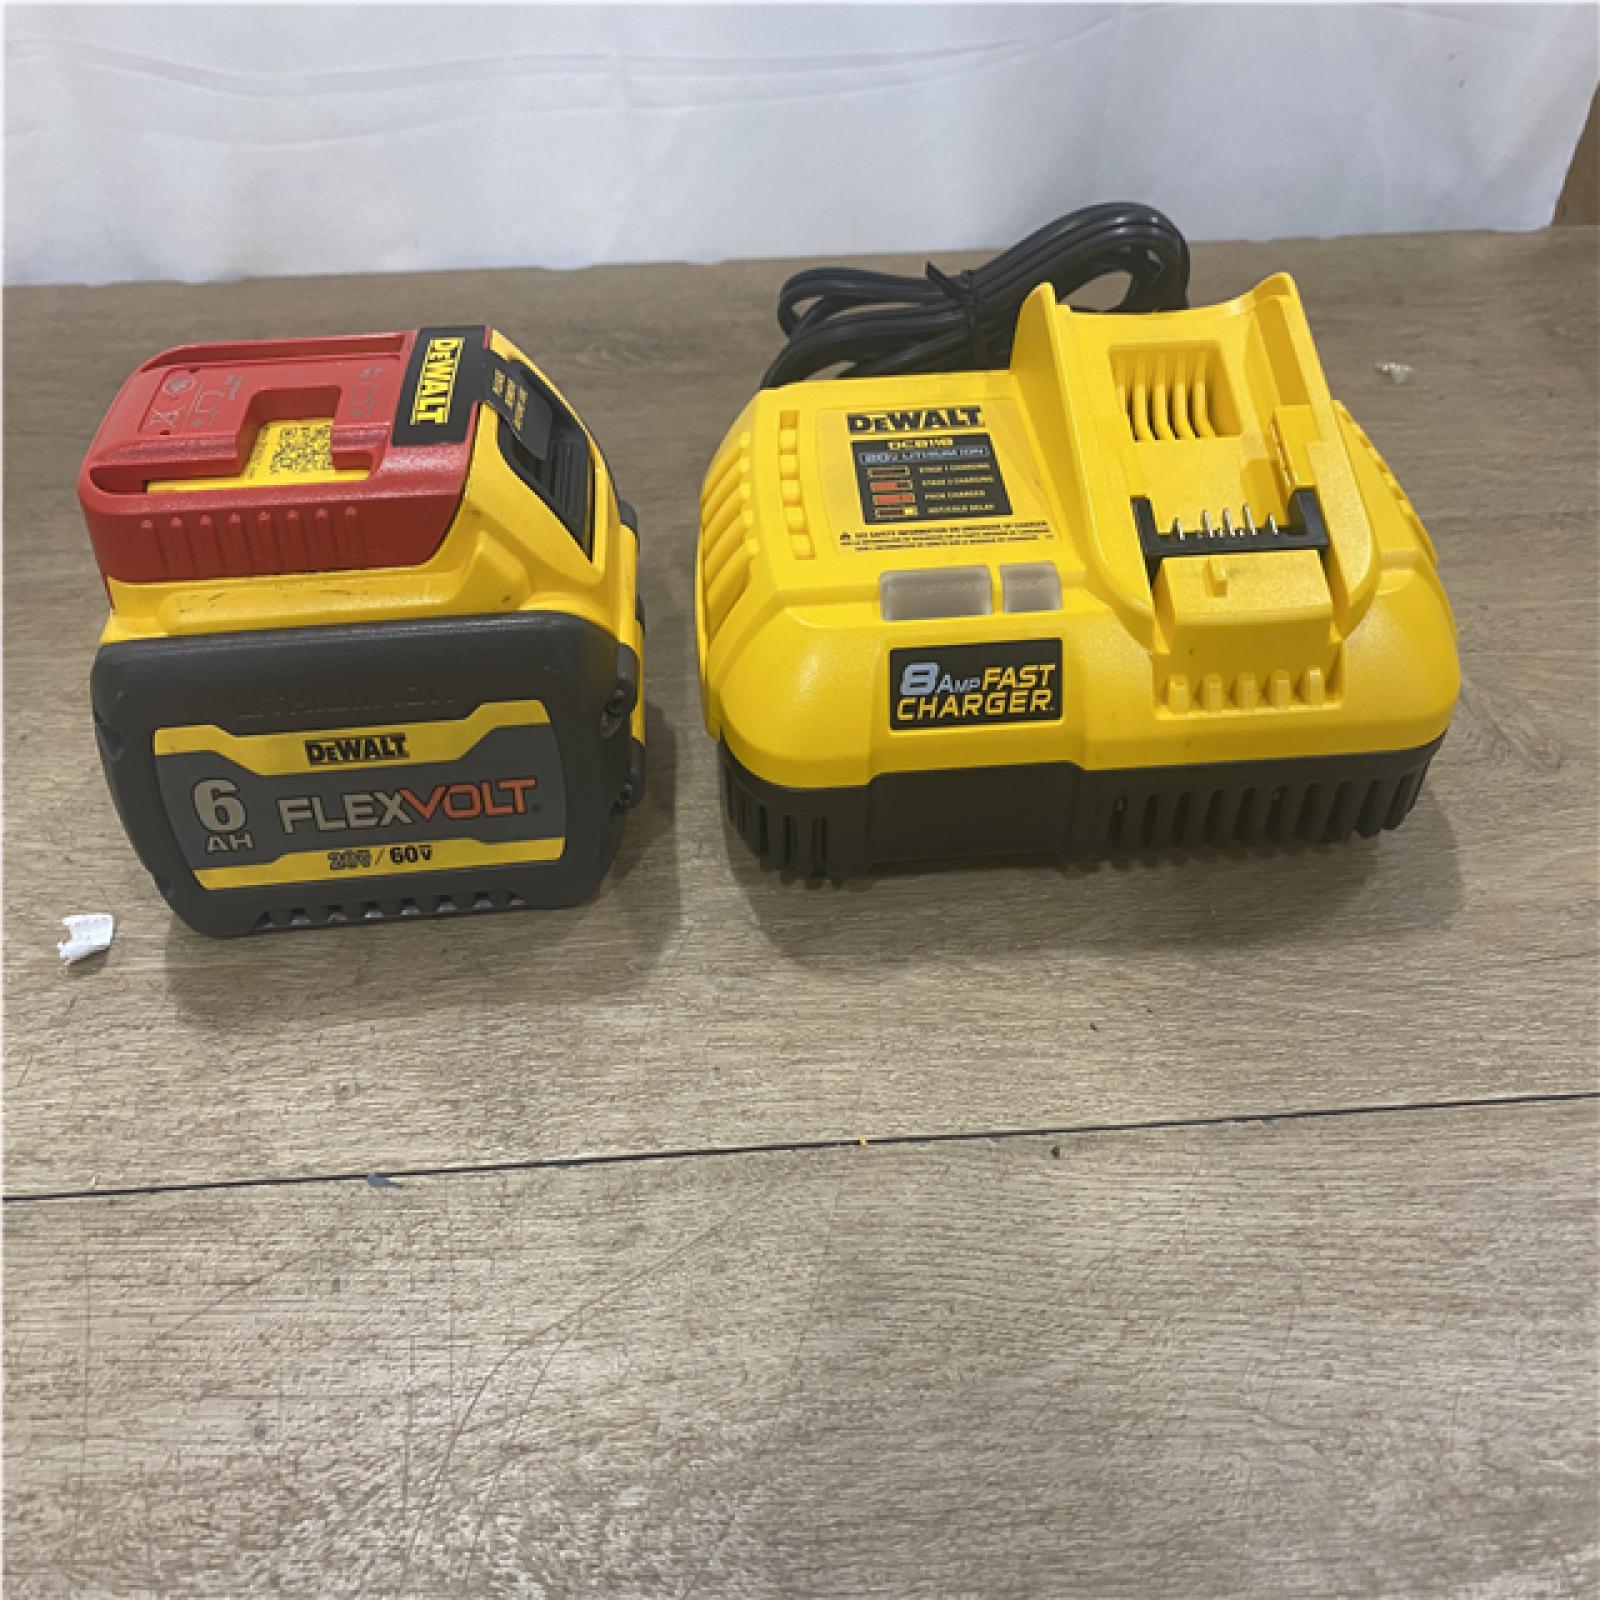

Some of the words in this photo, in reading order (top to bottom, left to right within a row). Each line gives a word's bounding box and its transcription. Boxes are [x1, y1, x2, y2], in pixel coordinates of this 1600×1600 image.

[847, 405, 984, 434] DEWALT
[901, 662, 940, 696] 8
[936, 674, 981, 694] AMP
[982, 663, 1056, 691] FAST
[897, 689, 1054, 721] CHARGER
[305, 733, 410, 767] DEWALT
[193, 779, 248, 834] 6
[276, 778, 538, 834] FLEXVOLT
[206, 831, 254, 853] AH
